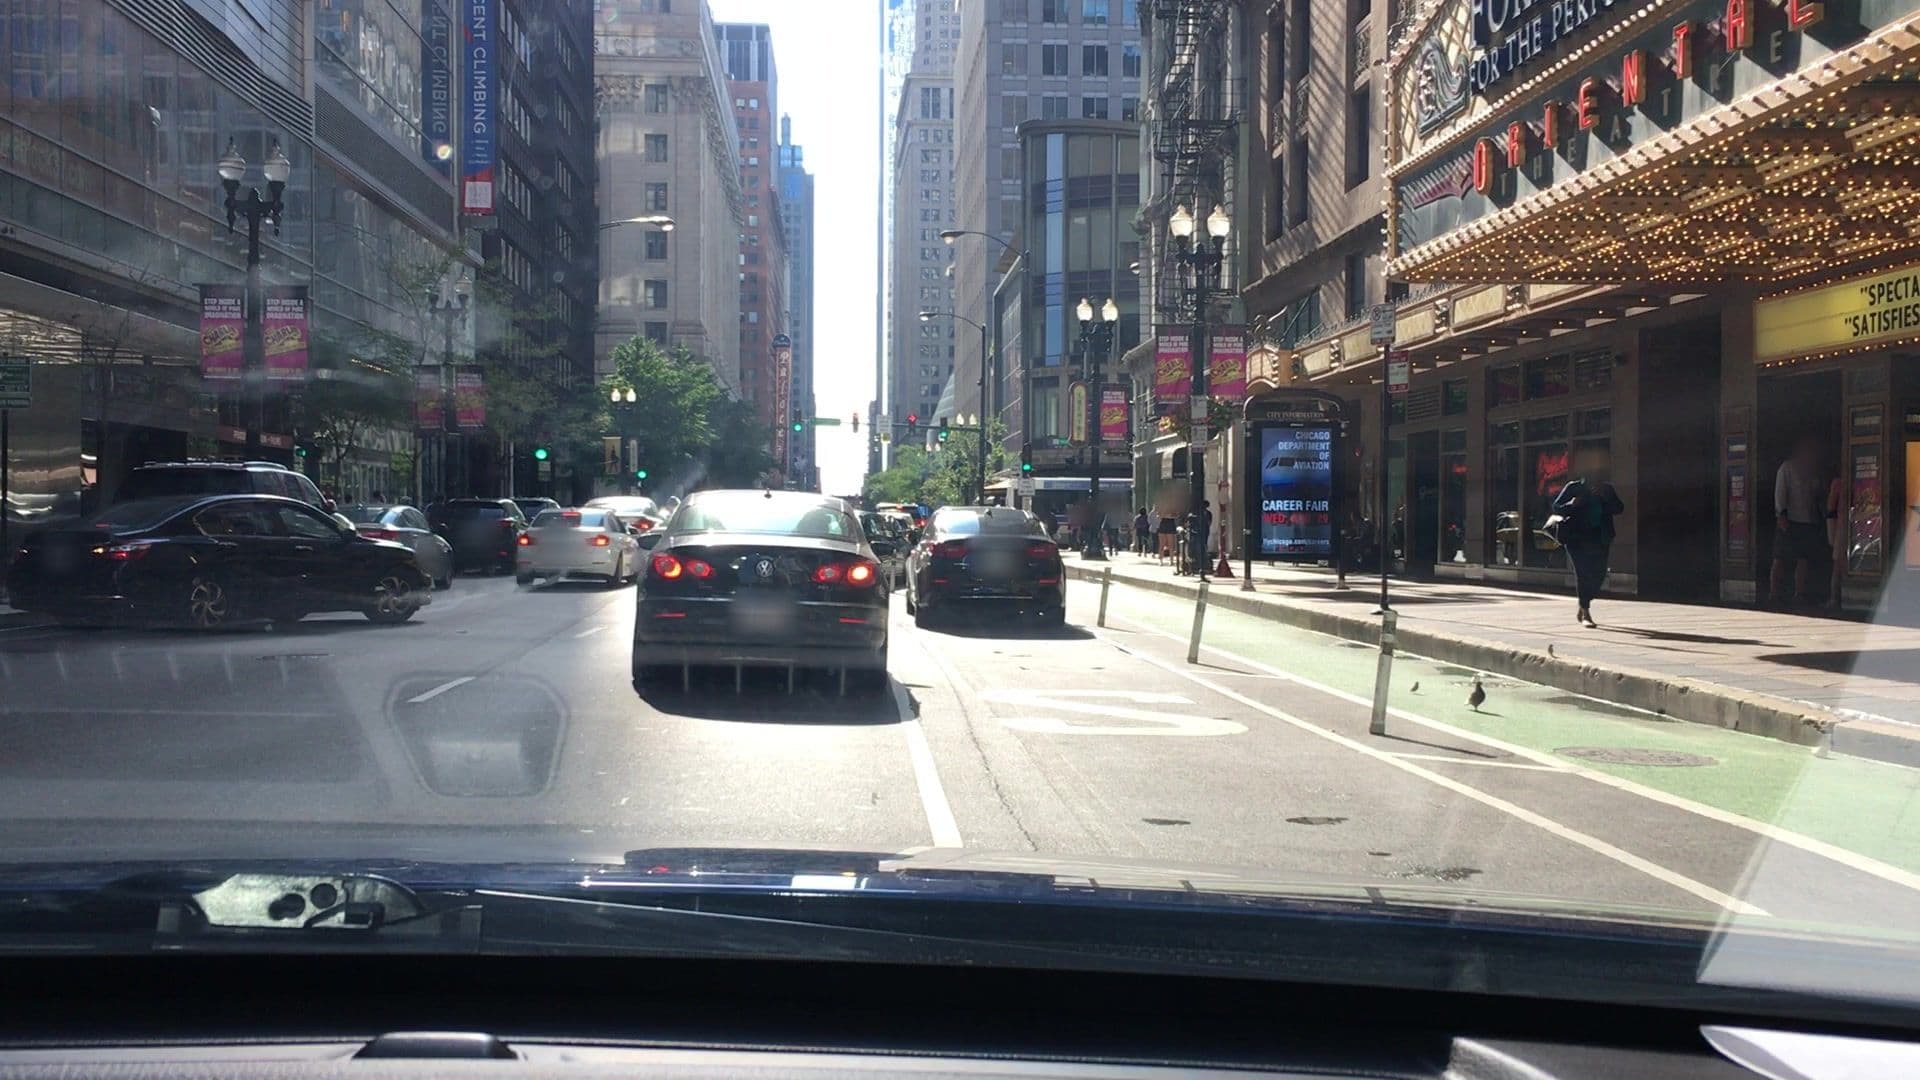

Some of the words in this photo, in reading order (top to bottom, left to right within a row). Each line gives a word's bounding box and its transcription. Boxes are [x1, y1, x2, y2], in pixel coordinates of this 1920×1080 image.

[1468, 47, 1501, 91] FOR
[1505, 14, 1543, 72] THE
[1551, 0, 1614, 43] PER
[473, 46, 488, 134] CLIMBING
[1844, 303, 1920, 337] "SATISFIES
[1295, 431, 1330, 440] CHICAGO
[1278, 441, 1330, 450] DEPARTMENT
[1319, 451, 1330, 460] OF
[1293, 461, 1329, 470] AVIATION
[1262, 499, 1303, 511] CAREER
[1305, 500, 1329, 511] FAIR
